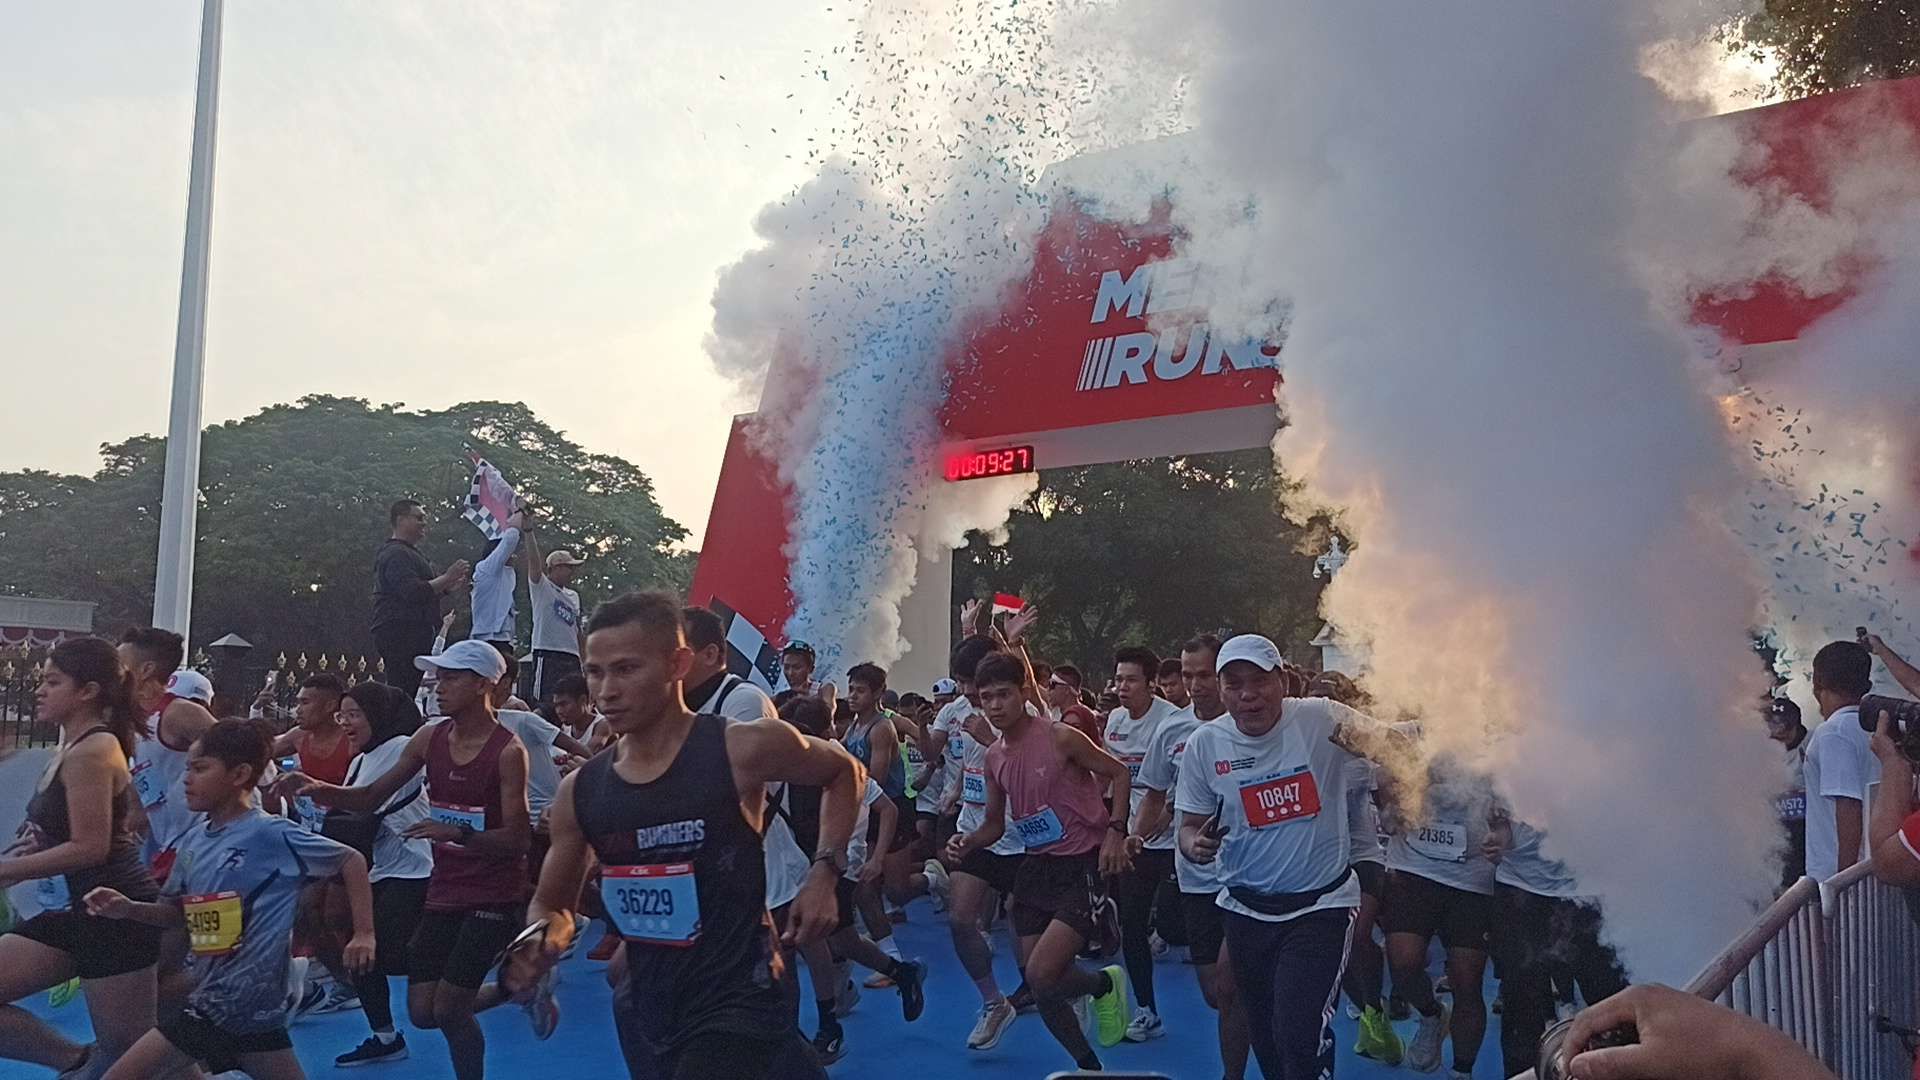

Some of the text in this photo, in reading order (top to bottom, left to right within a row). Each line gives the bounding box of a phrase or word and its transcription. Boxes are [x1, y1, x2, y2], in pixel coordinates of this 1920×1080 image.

[948, 448, 1028, 478] 00:09:27
[1256, 782, 1300, 810] 10847
[636, 819, 705, 849] RUNNERS
[1016, 818, 1050, 838] 34693
[1418, 827, 1454, 846] 21385
[617, 888, 674, 916] 36229
